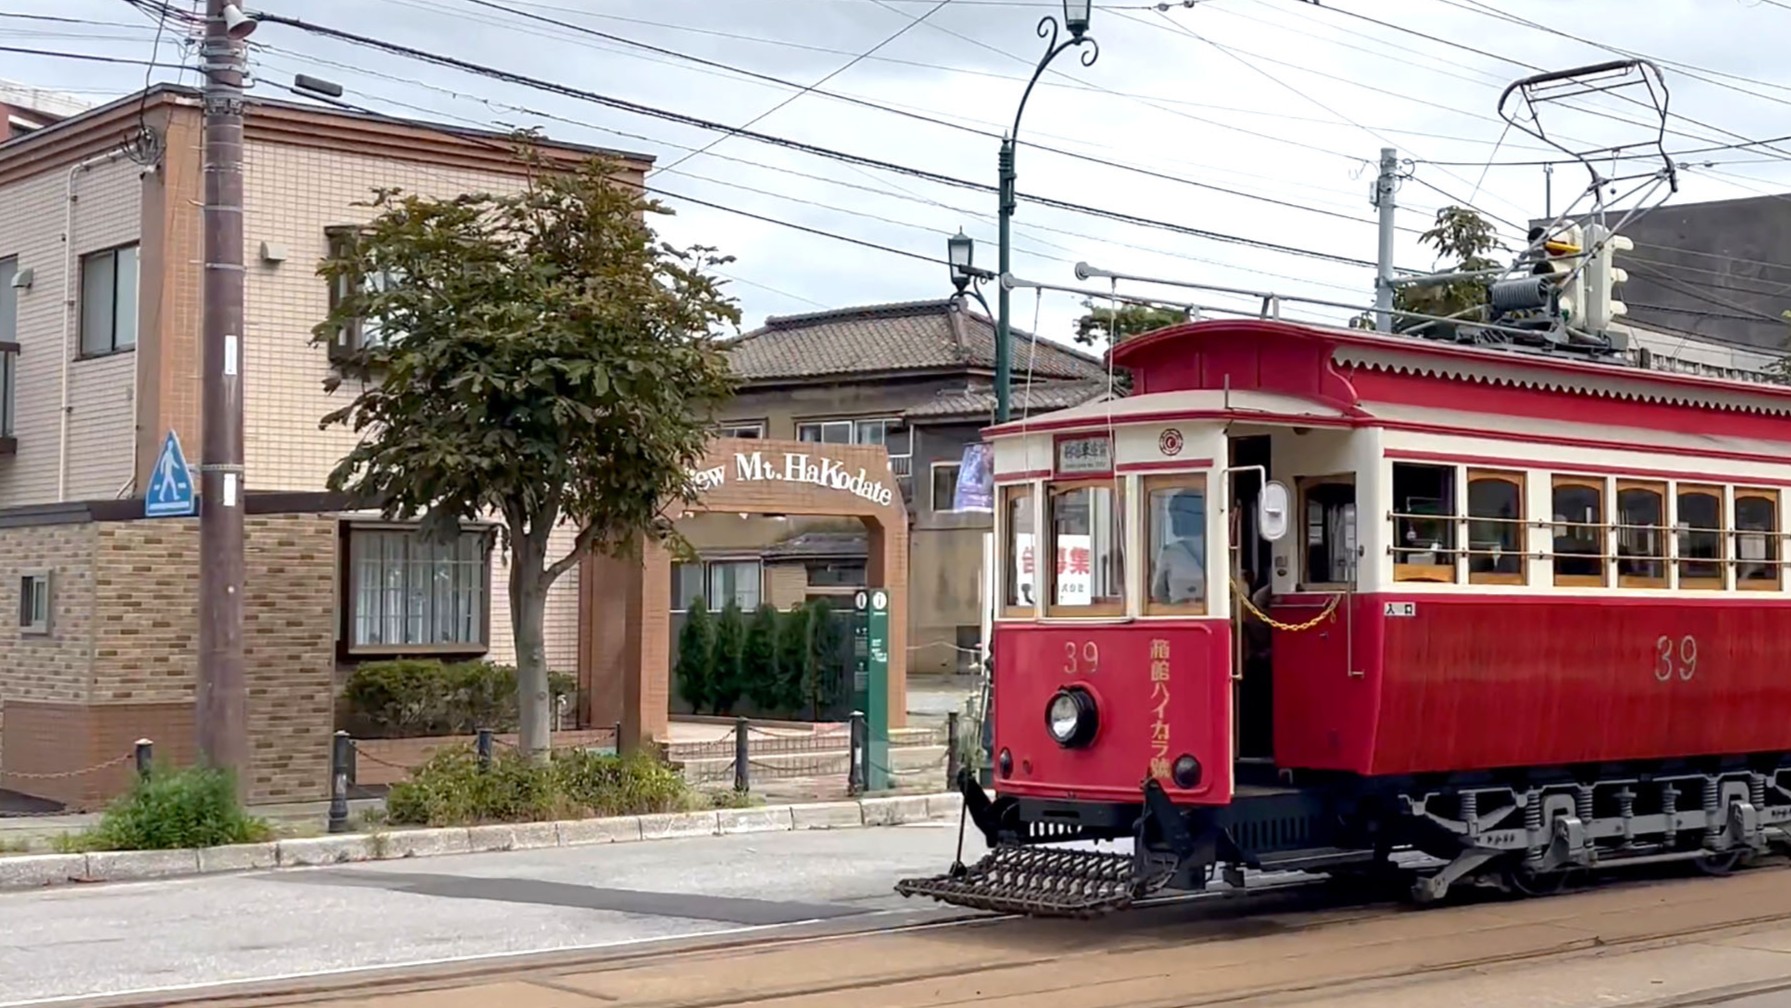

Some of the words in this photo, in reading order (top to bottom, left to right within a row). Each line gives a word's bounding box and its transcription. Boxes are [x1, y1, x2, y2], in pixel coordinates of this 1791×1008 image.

[1386, 603, 1413, 614] 入口
[1063, 641, 1099, 674] 39
[1654, 635, 1697, 681] 39
